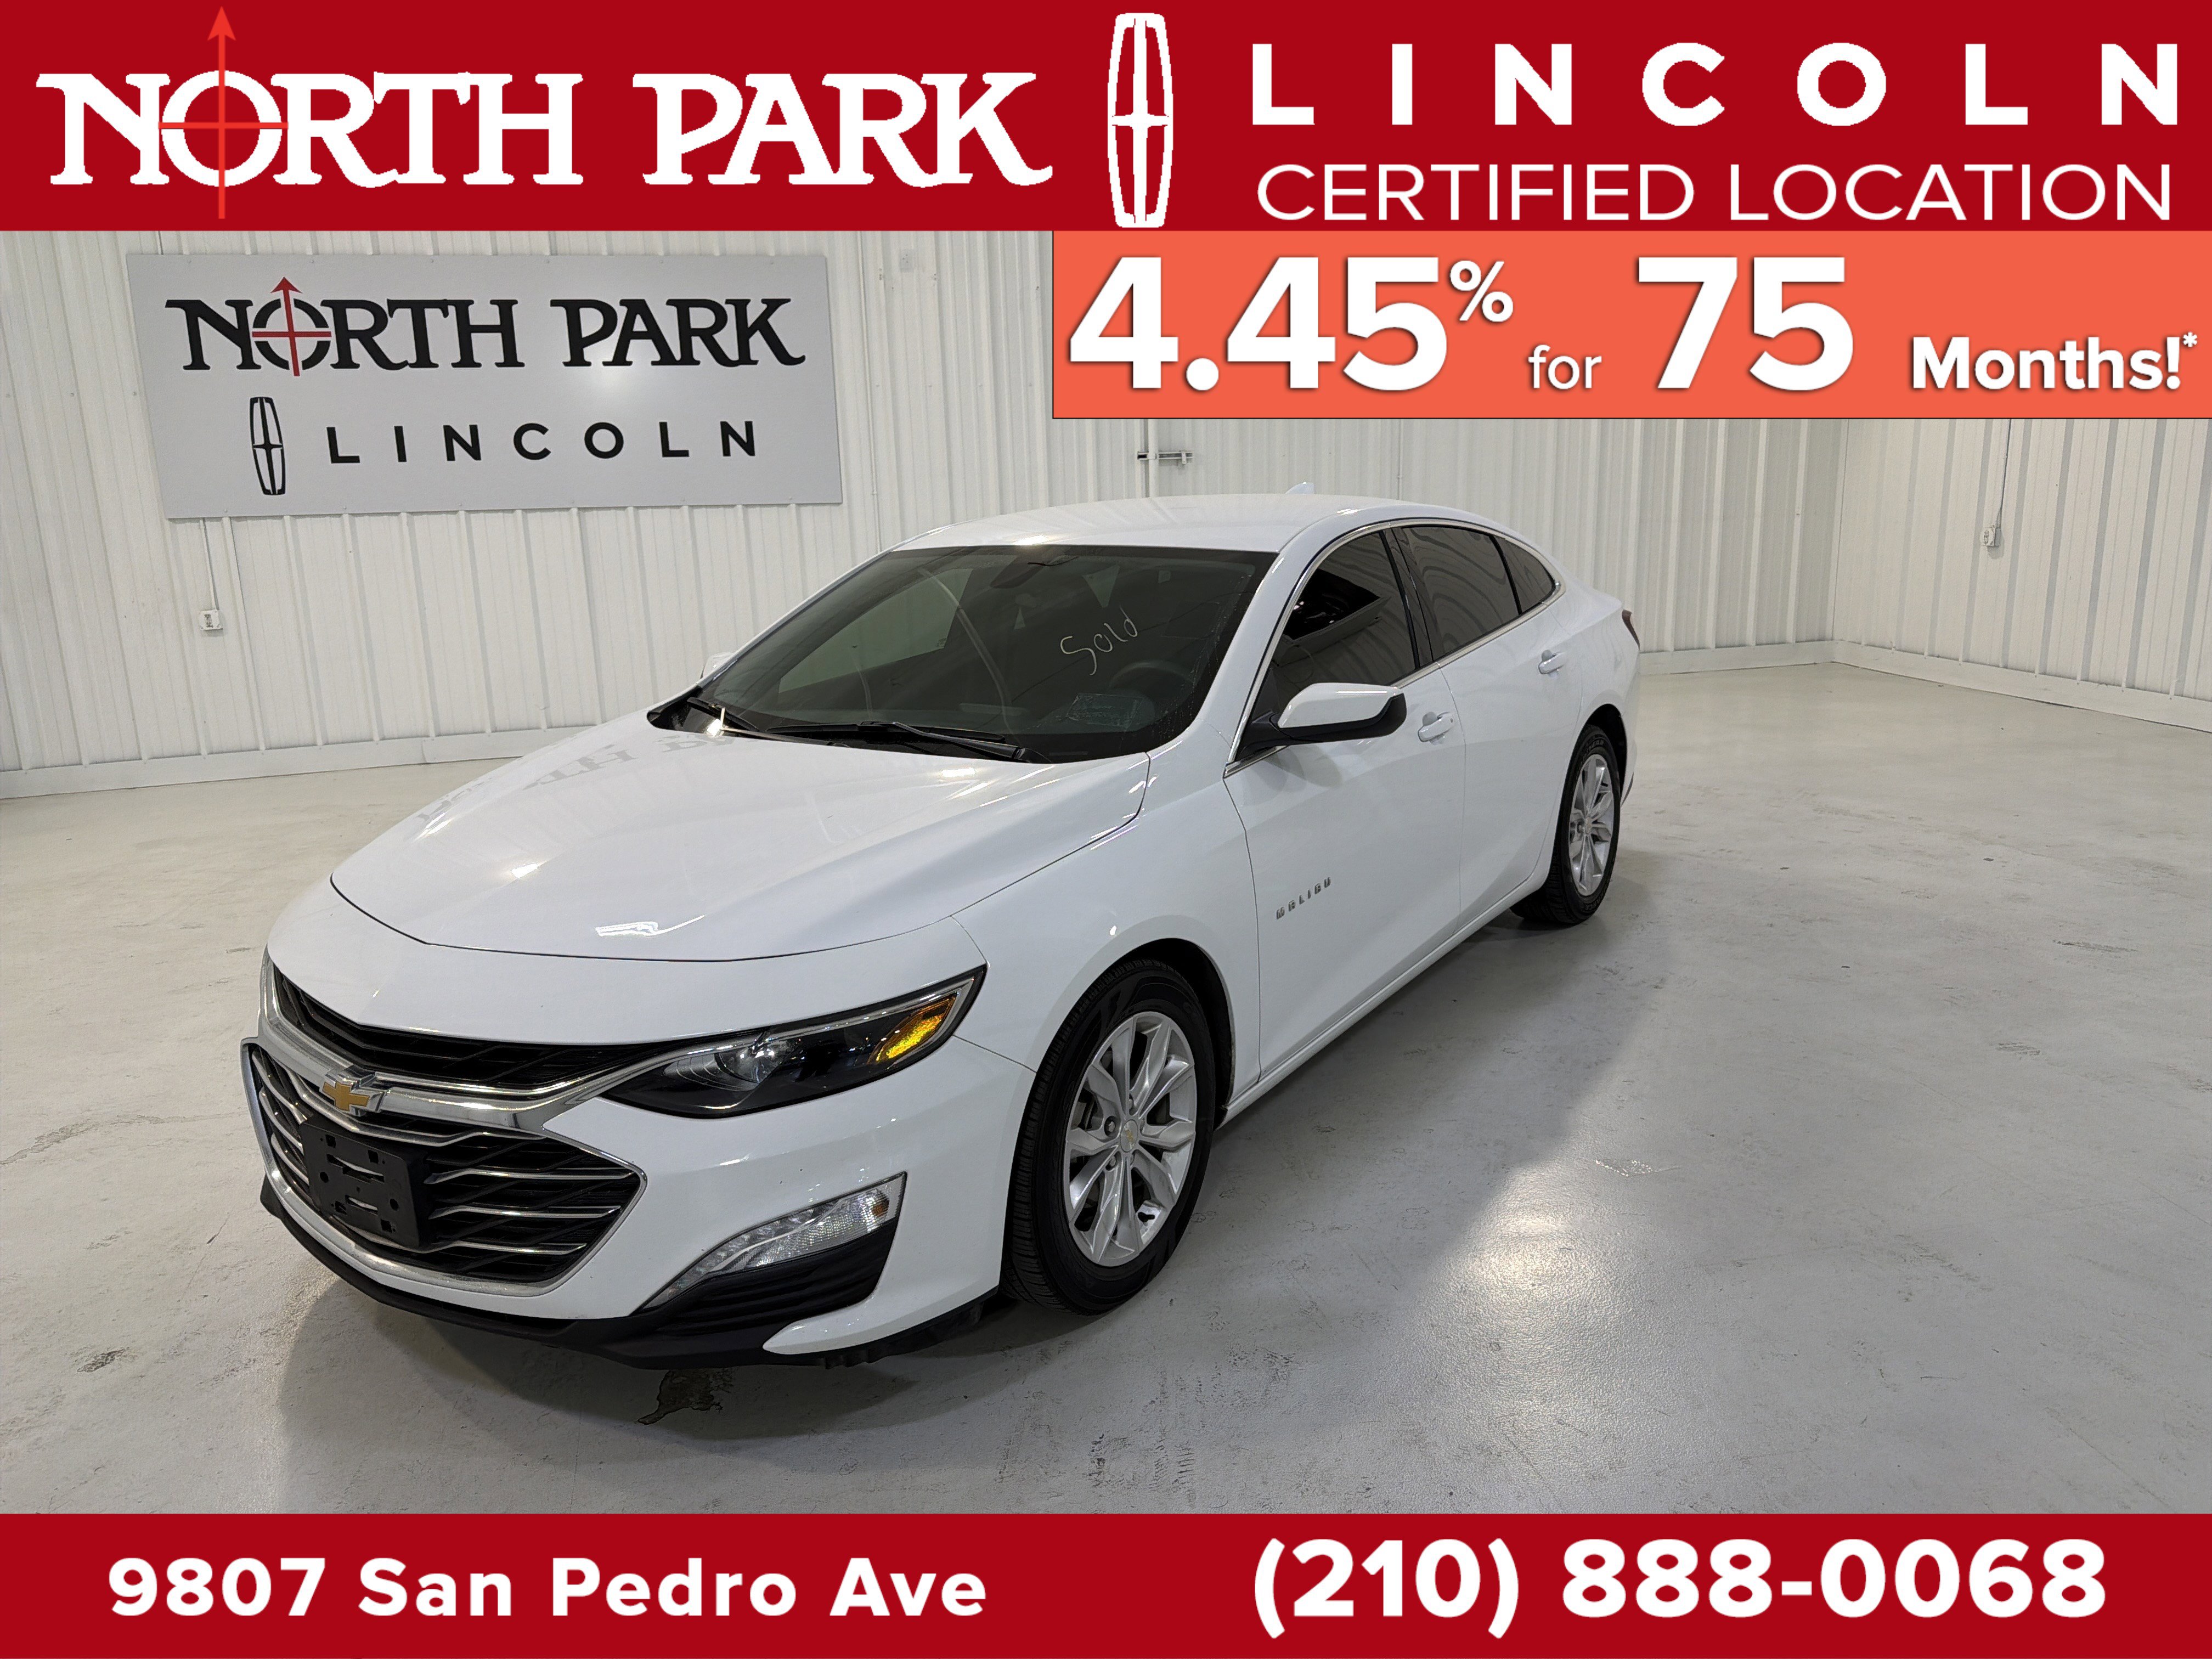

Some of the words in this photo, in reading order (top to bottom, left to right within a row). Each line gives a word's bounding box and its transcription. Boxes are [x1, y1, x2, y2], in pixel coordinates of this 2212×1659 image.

[165, 298, 524, 370] NORTH
[550, 298, 805, 367] PARK
[327, 421, 755, 464] LINCOLN
[1059, 605, 1138, 676] Sold
[1276, 876, 1331, 919] MALIBU
